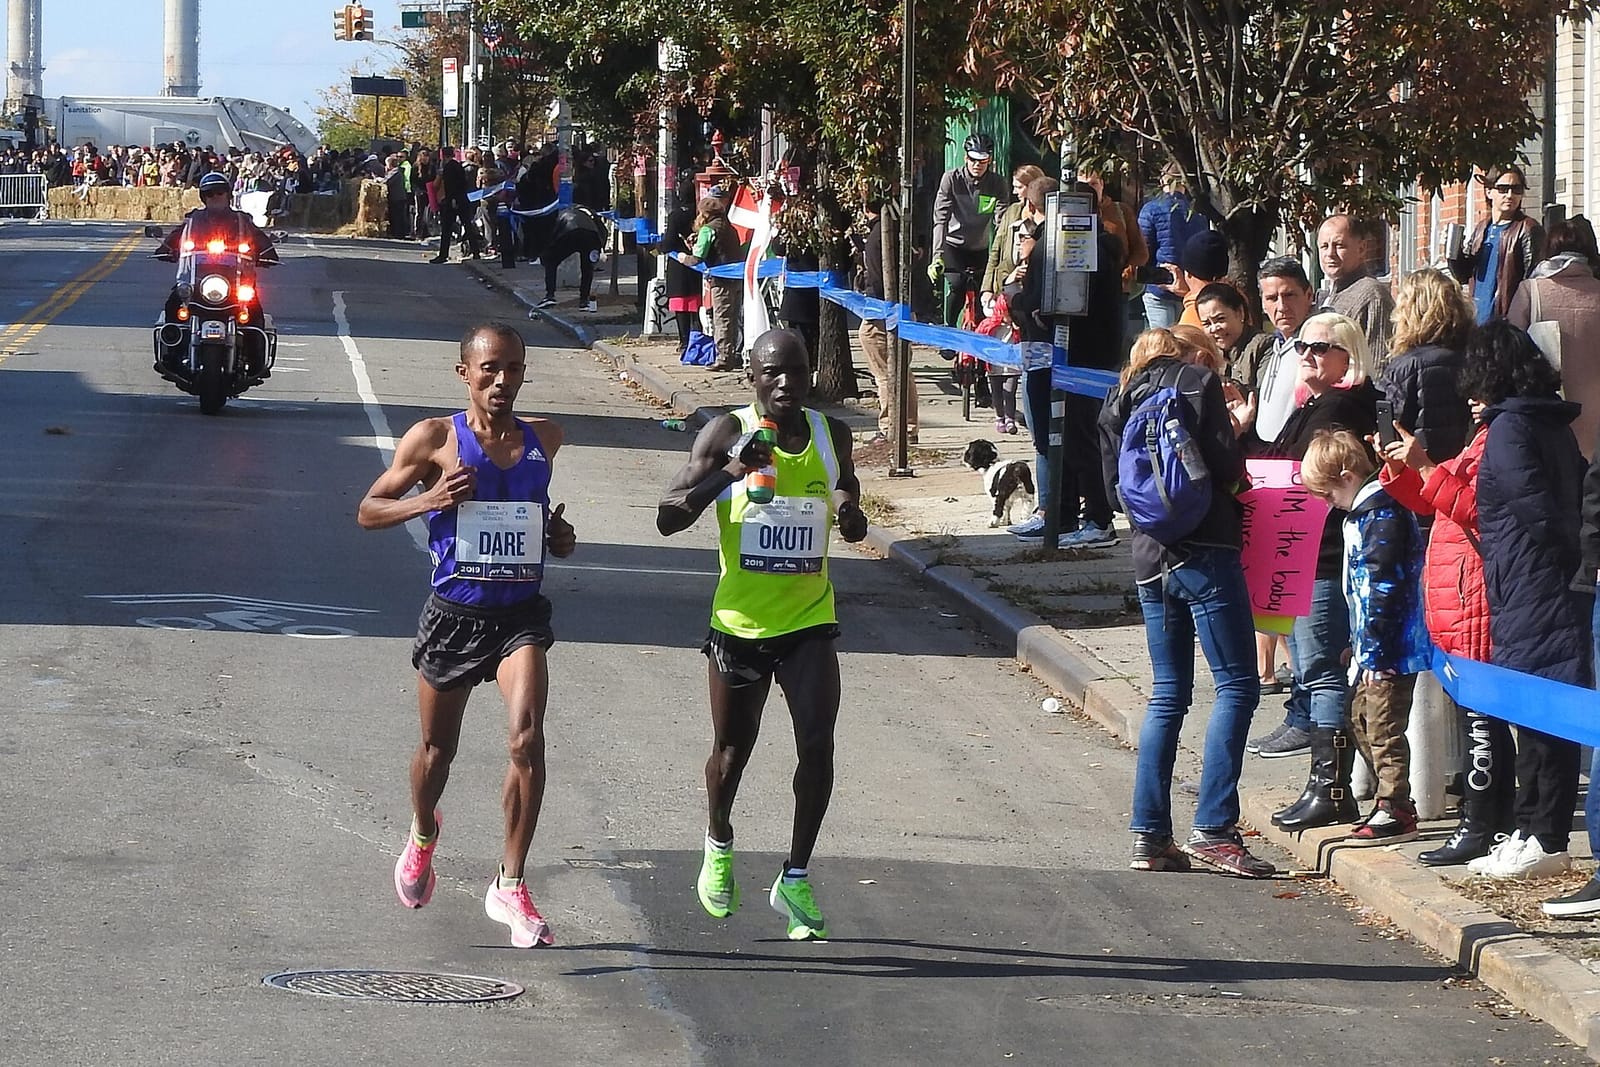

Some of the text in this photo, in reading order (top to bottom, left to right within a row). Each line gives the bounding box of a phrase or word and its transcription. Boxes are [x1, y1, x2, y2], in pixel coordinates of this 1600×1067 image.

[478, 531, 526, 557] DARE
[759, 524, 813, 551] OKUTI
[1275, 526, 1308, 560] the
[460, 565, 481, 574] 2019
[744, 558, 764, 568] 2019
[1252, 570, 1301, 612] baby
[1467, 720, 1493, 791] Calvin
